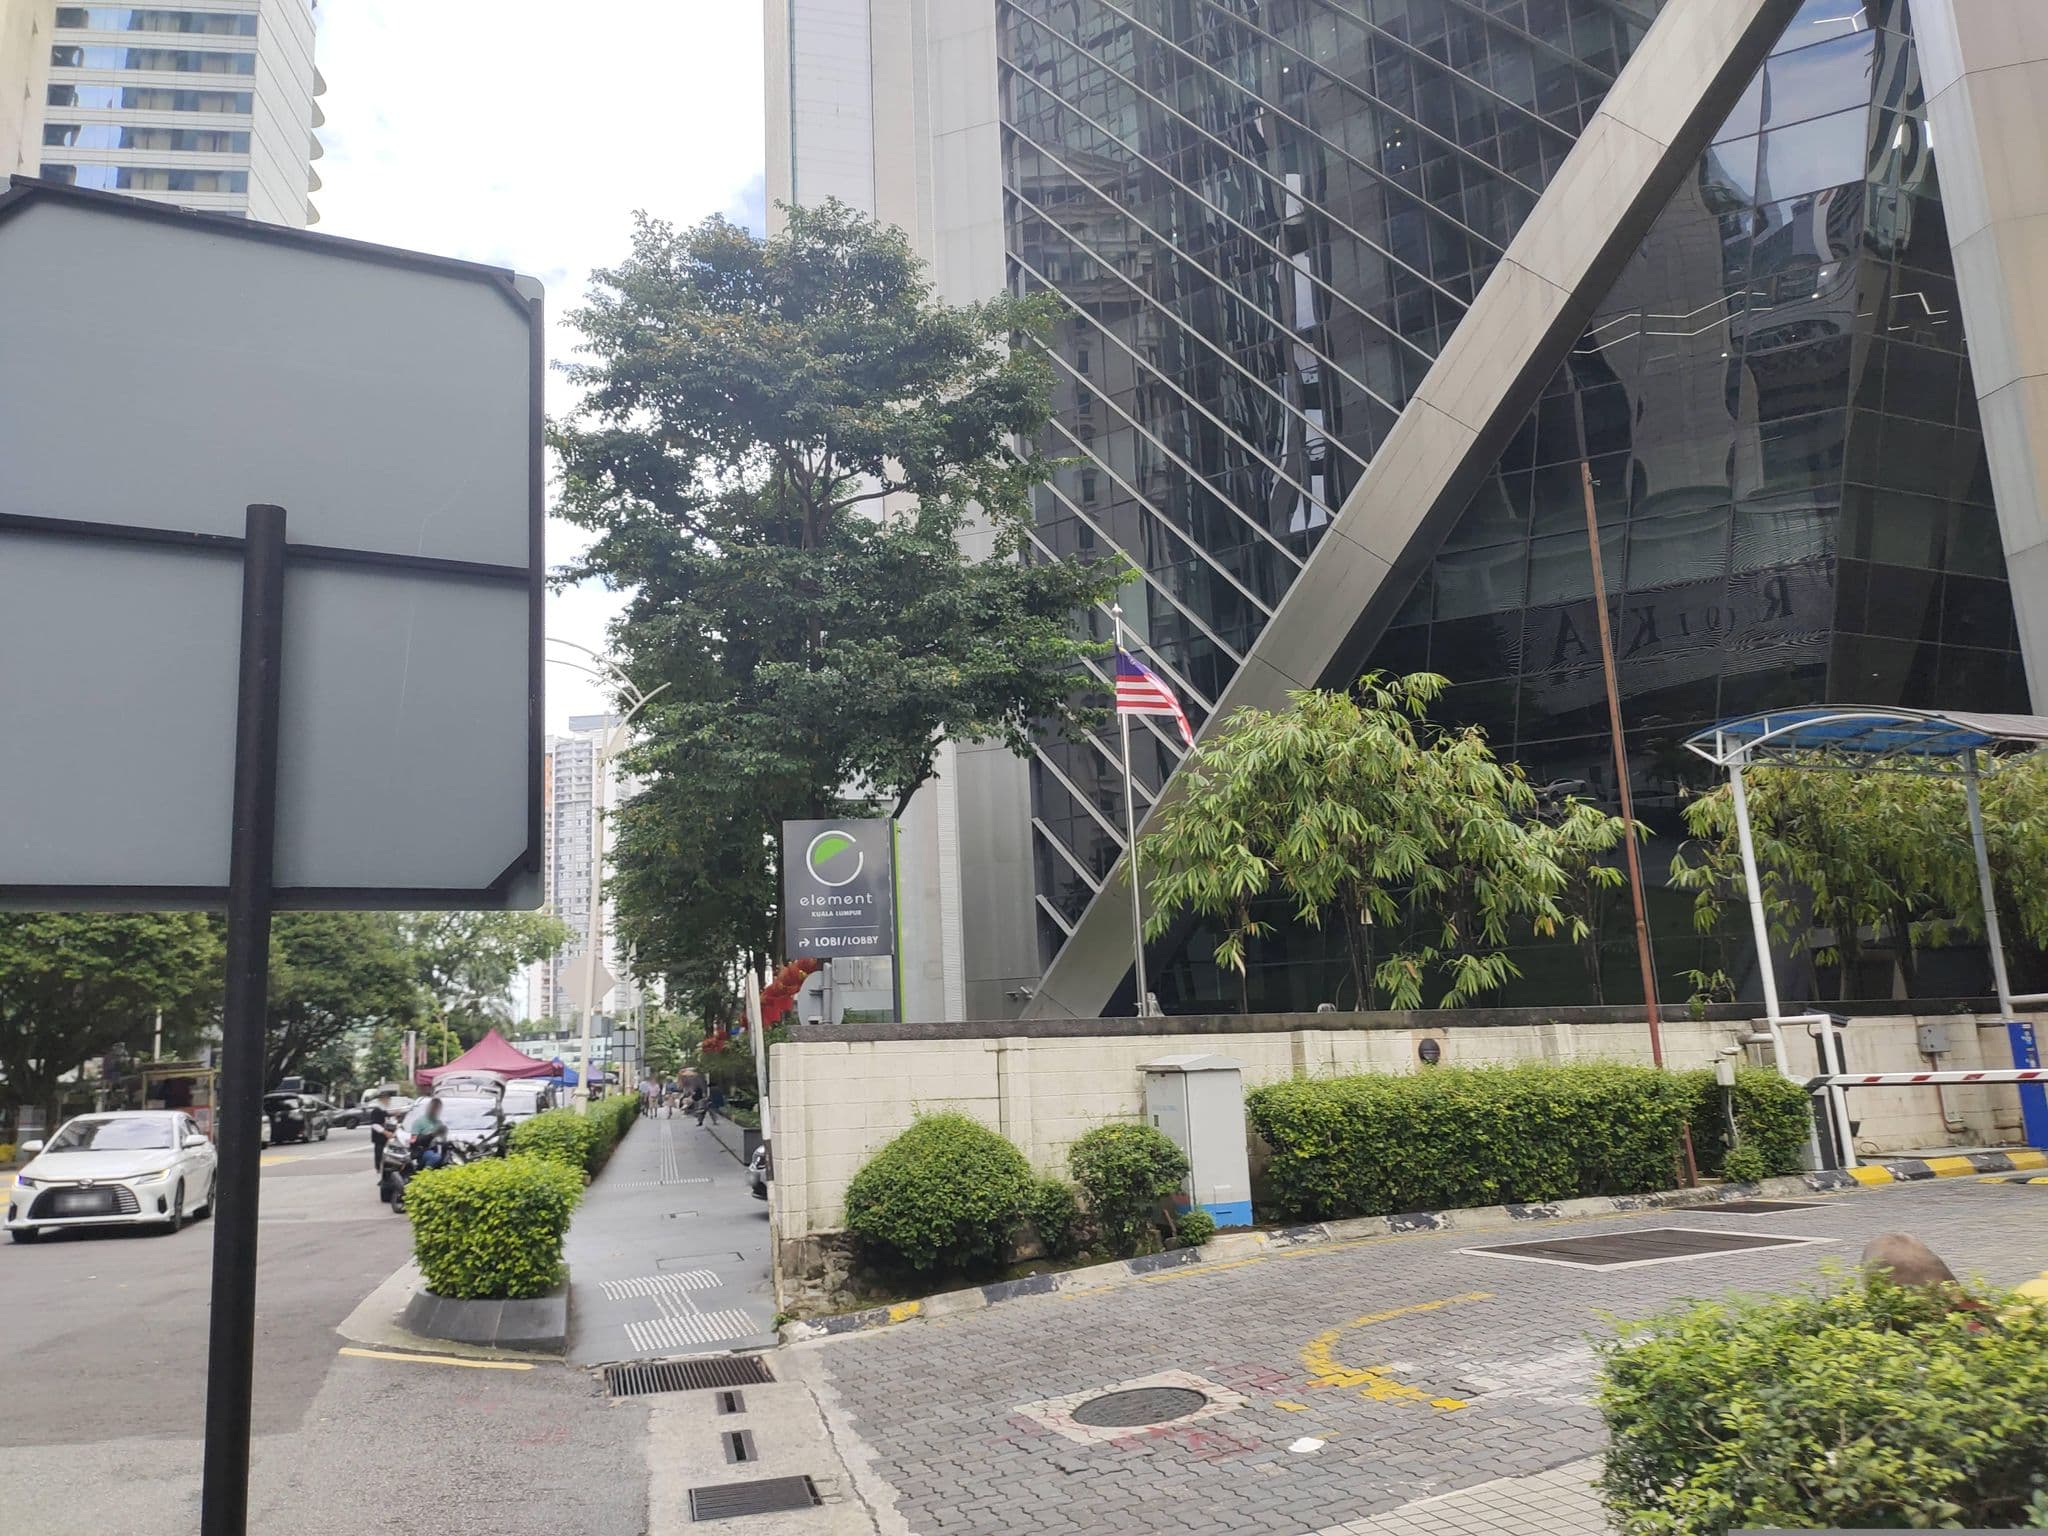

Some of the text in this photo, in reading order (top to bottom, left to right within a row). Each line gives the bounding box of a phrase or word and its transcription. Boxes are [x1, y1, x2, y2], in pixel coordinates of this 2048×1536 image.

[800, 893, 873, 906] element
[835, 909, 862, 917] LUMPUR
[815, 935, 879, 947] LOBI/LOBBY
